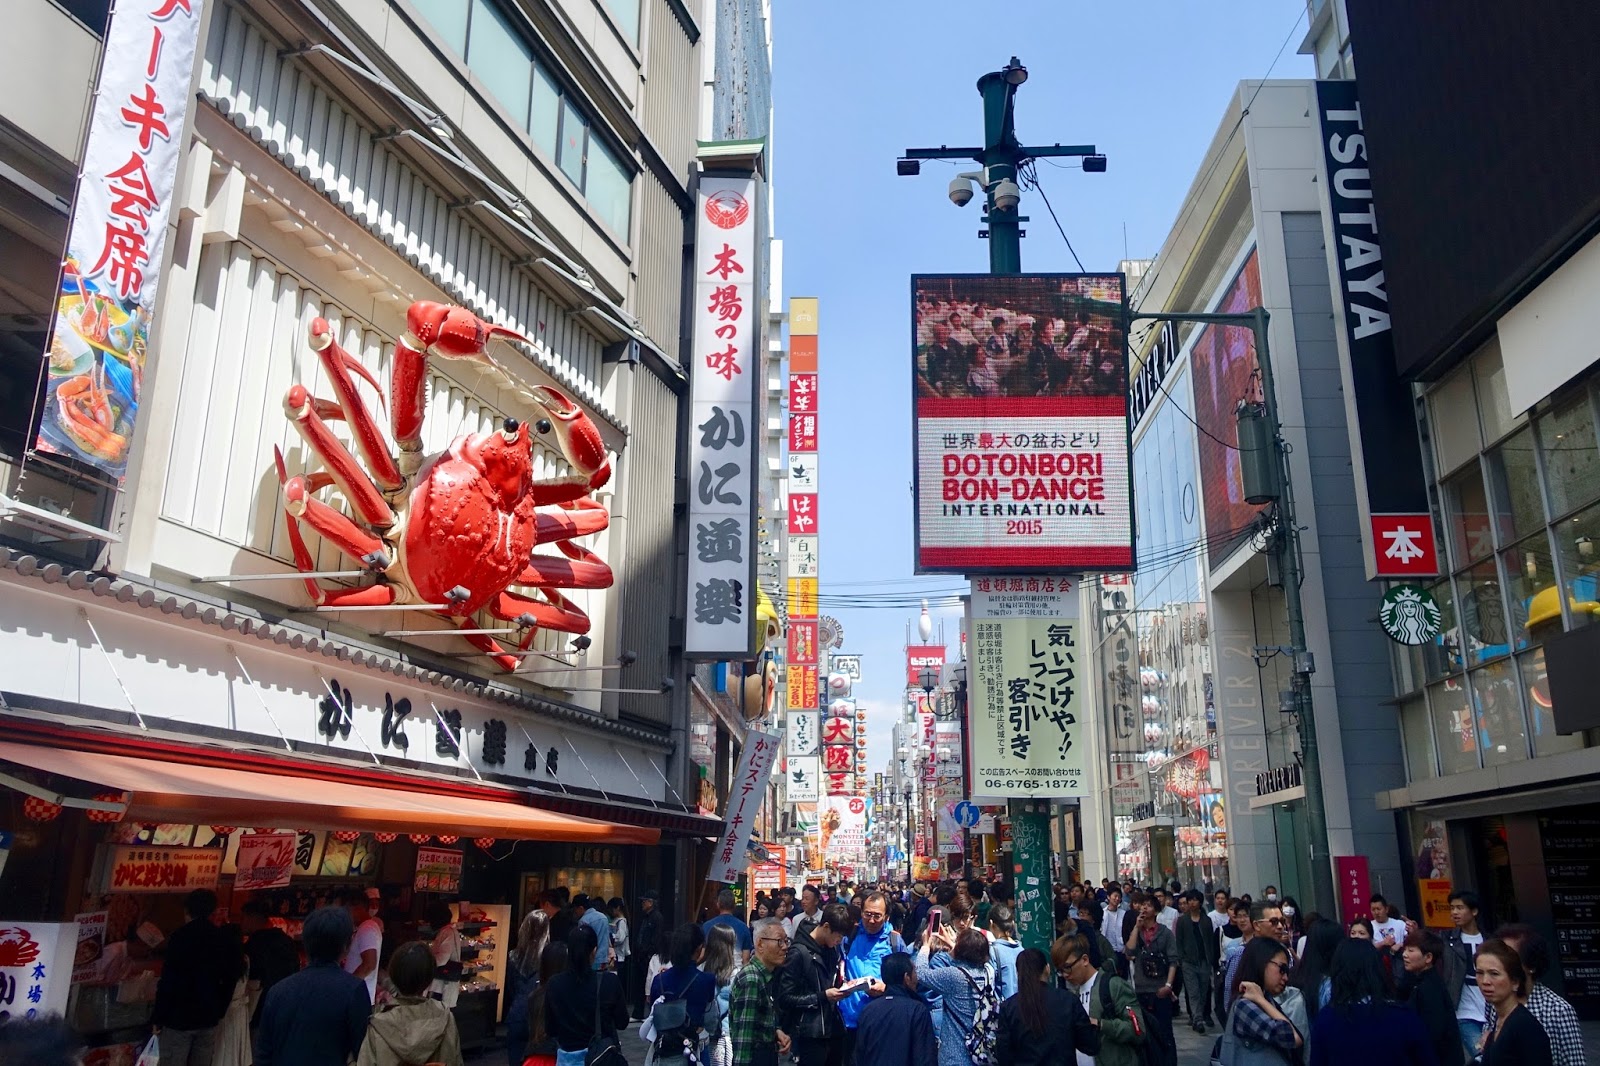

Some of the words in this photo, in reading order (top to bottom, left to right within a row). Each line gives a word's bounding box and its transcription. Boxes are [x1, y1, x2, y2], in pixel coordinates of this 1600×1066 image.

[1326, 101, 1392, 340] TSUTAYA
[706, 243, 744, 382] 本場の味
[1130, 344, 1160, 431] REVER
[1162, 320, 1175, 375] 21
[804, 416, 814, 436] 相席
[942, 432, 1100, 450] 世界最大の盆おどり
[942, 453, 1103, 477] DOTONBORI
[942, 477, 1105, 501] BON-DANCE
[943, 503, 1105, 516] INTERNATIONAL
[1006, 520, 1043, 535] 2015
[798, 540, 816, 574] 白木屋
[1382, 526, 1424, 564] 本
[977, 577, 1072, 593] 道頓堀商店会
[976, 623, 986, 684] 注意しましょう。
[1029, 639, 1050, 722] しつこい
[1008, 677, 1031, 760] 客引き
[1224, 676, 1266, 817] FOREVER
[980, 768, 1082, 776] この広告スペースのお問い合わせは
[984, 780, 1078, 788] 06-6765-1872
[1256, 768, 1285, 796] FOREVER
[1288, 764, 1296, 787] 21
[719, 738, 769, 865] かにステーキ会席
[850, 802, 862, 810] 2F
[27, 962, 46, 1020] 本場の
